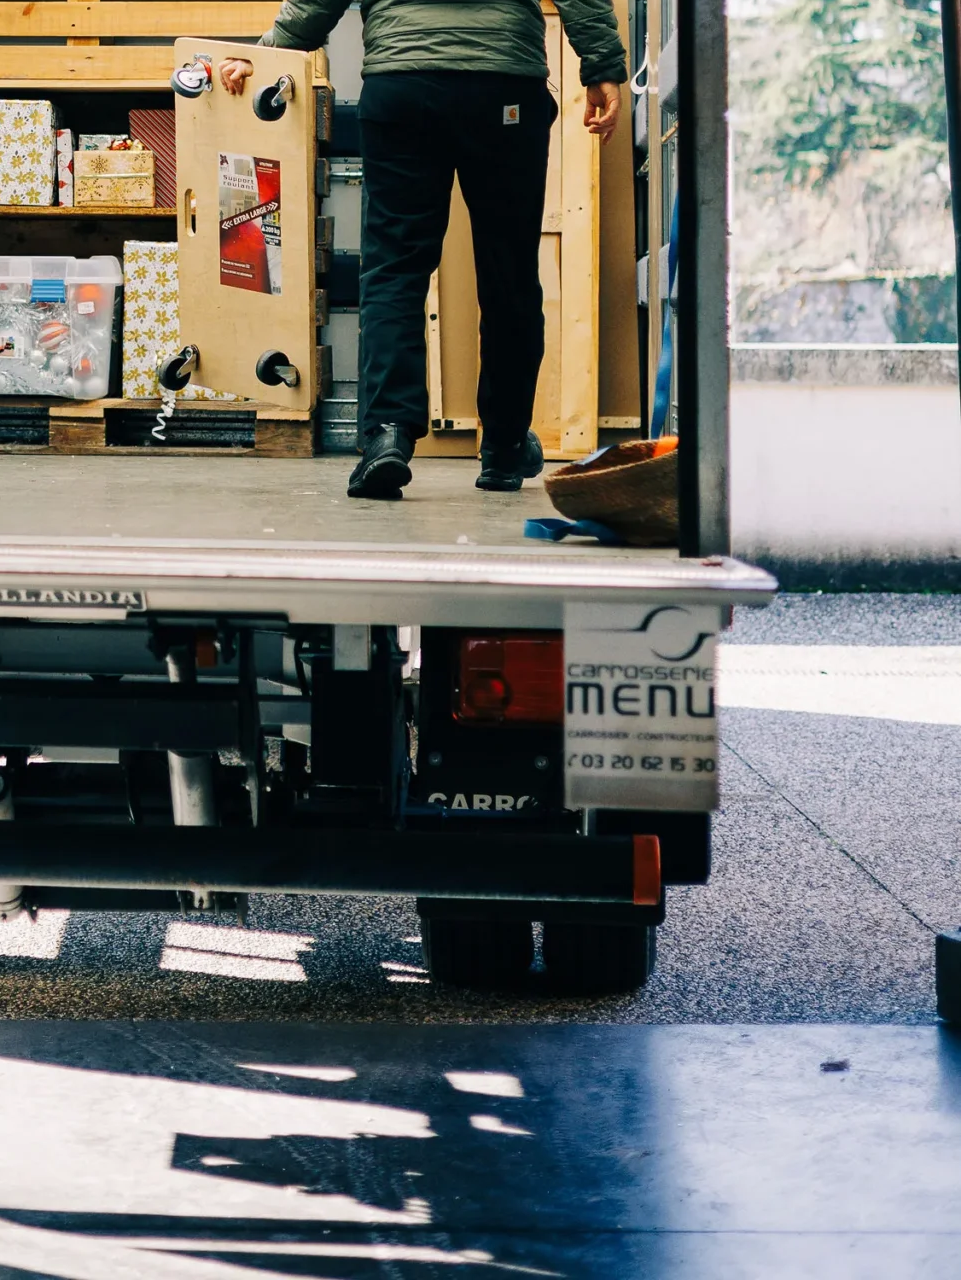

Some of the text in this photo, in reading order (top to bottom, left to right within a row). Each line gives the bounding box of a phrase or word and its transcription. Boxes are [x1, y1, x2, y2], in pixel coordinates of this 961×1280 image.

[223, 174, 254, 185] Support
[223, 181, 254, 191] roulant
[233, 205, 268, 226] EXTRA LARGE
[637, 732, 716, 742] CONSTRUCTEUR
[581, 753, 716, 773] 03 20 62 15 30
